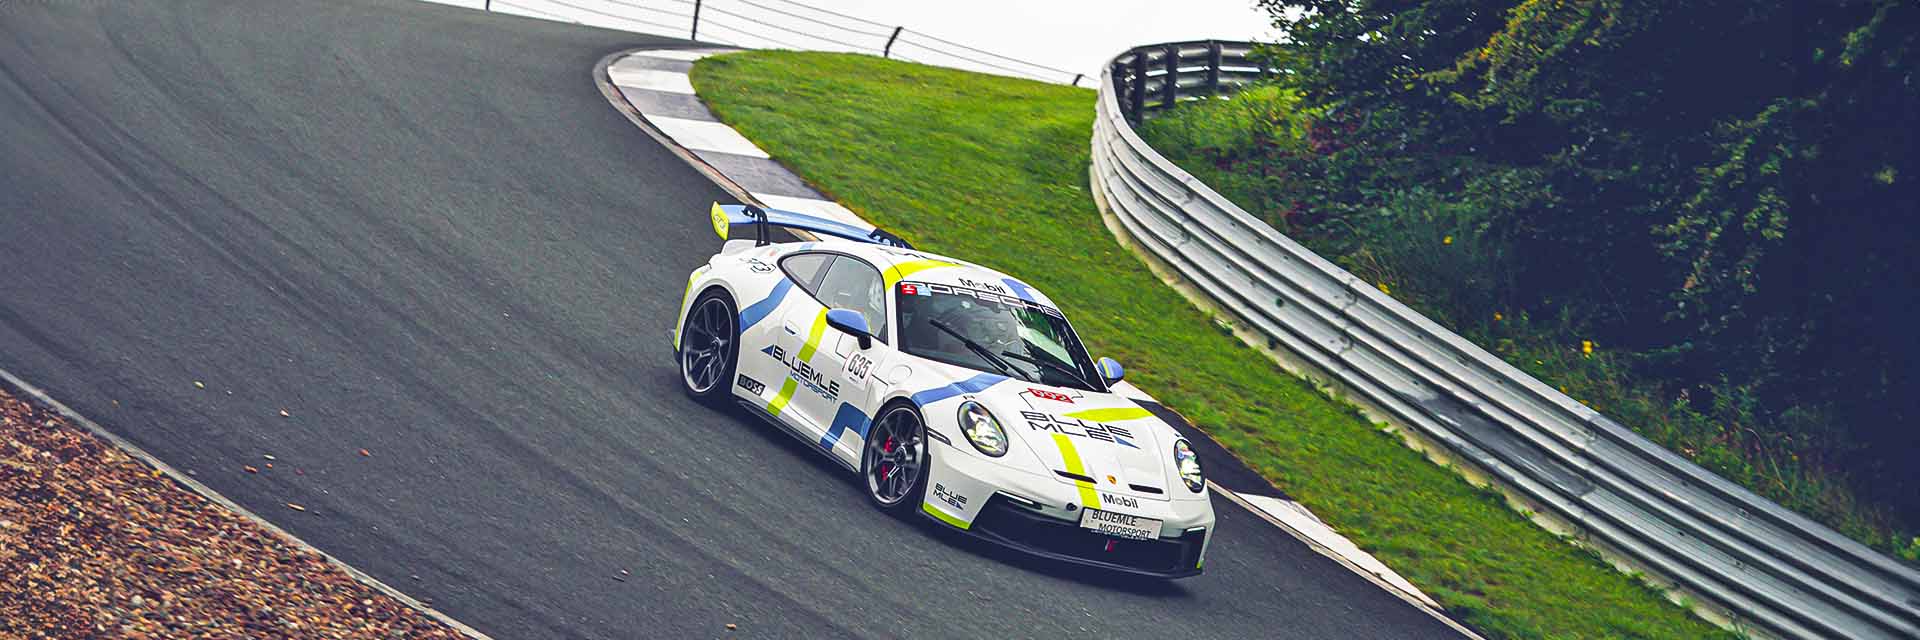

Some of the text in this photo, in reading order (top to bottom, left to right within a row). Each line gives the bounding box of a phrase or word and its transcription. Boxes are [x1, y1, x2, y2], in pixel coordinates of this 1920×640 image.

[958, 277, 1006, 294] Mobil
[772, 346, 840, 397] BLUEMLE
[848, 354, 872, 379] 635
[739, 375, 764, 395] BOSS
[790, 369, 838, 404] MOTORSPORT
[1020, 411, 1134, 439] BLUE
[1028, 421, 1115, 443] MLE
[933, 490, 957, 507] MLE
[935, 482, 968, 504] BLUE
[1102, 493, 1138, 508] Mobil
[1092, 510, 1137, 526] BLUEMLE
[1099, 523, 1151, 538] MOTORSPORT
